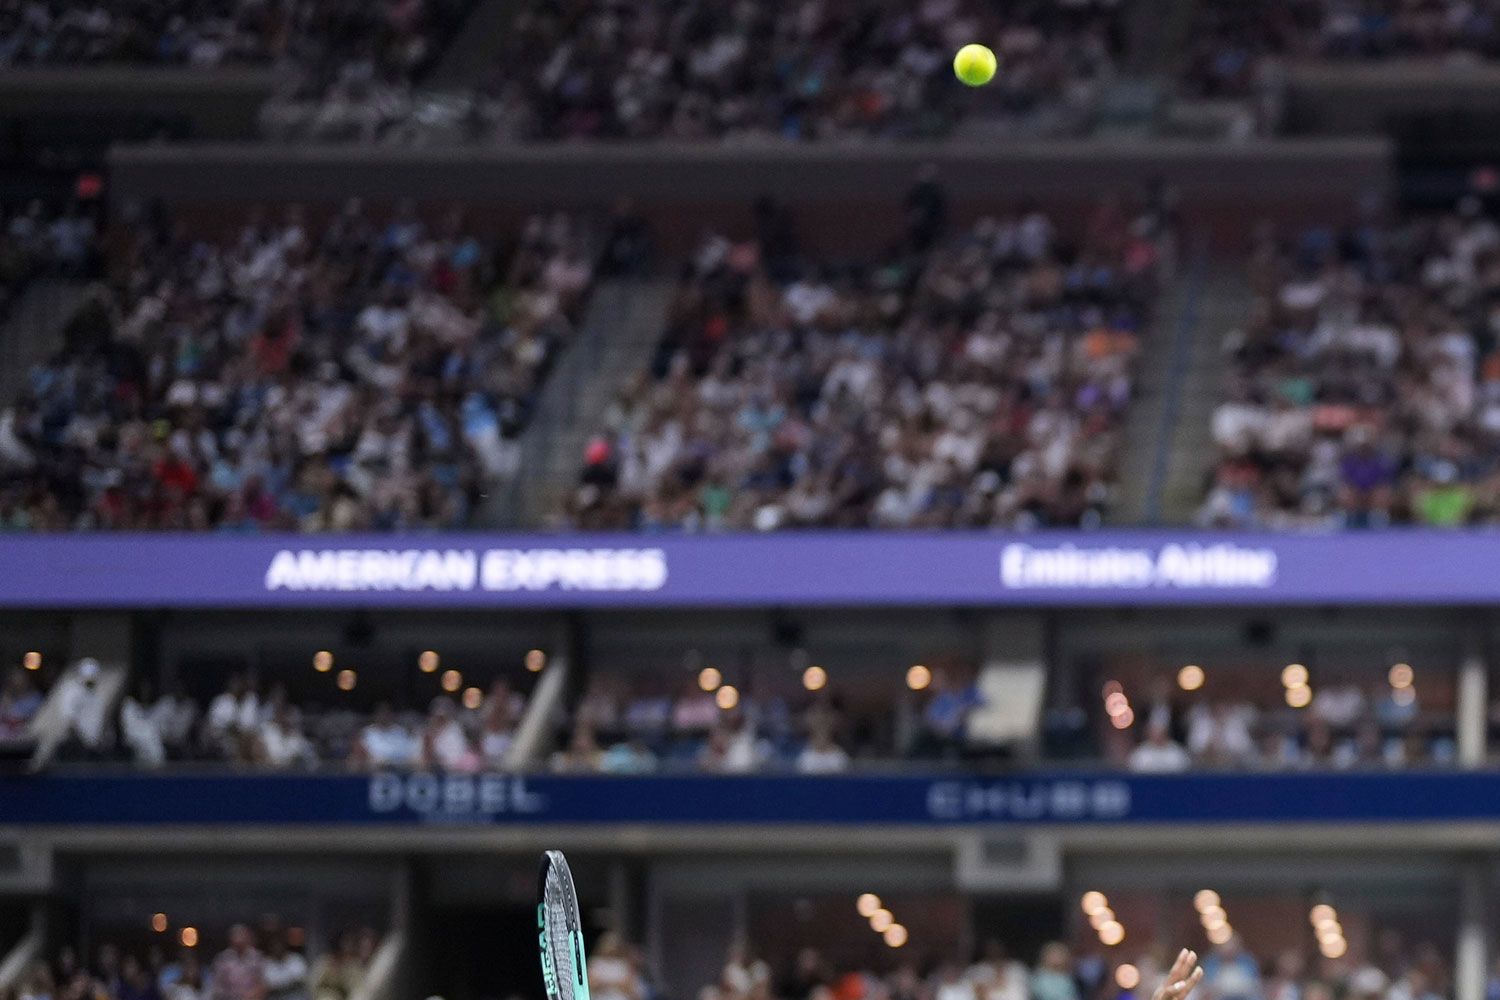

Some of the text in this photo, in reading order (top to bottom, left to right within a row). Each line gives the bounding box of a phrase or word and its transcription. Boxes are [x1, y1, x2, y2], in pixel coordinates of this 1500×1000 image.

[266, 549, 668, 591] AMERICAN EXPRESS
[369, 772, 541, 813] DOBEL
[927, 781, 1130, 817] CHUBB
